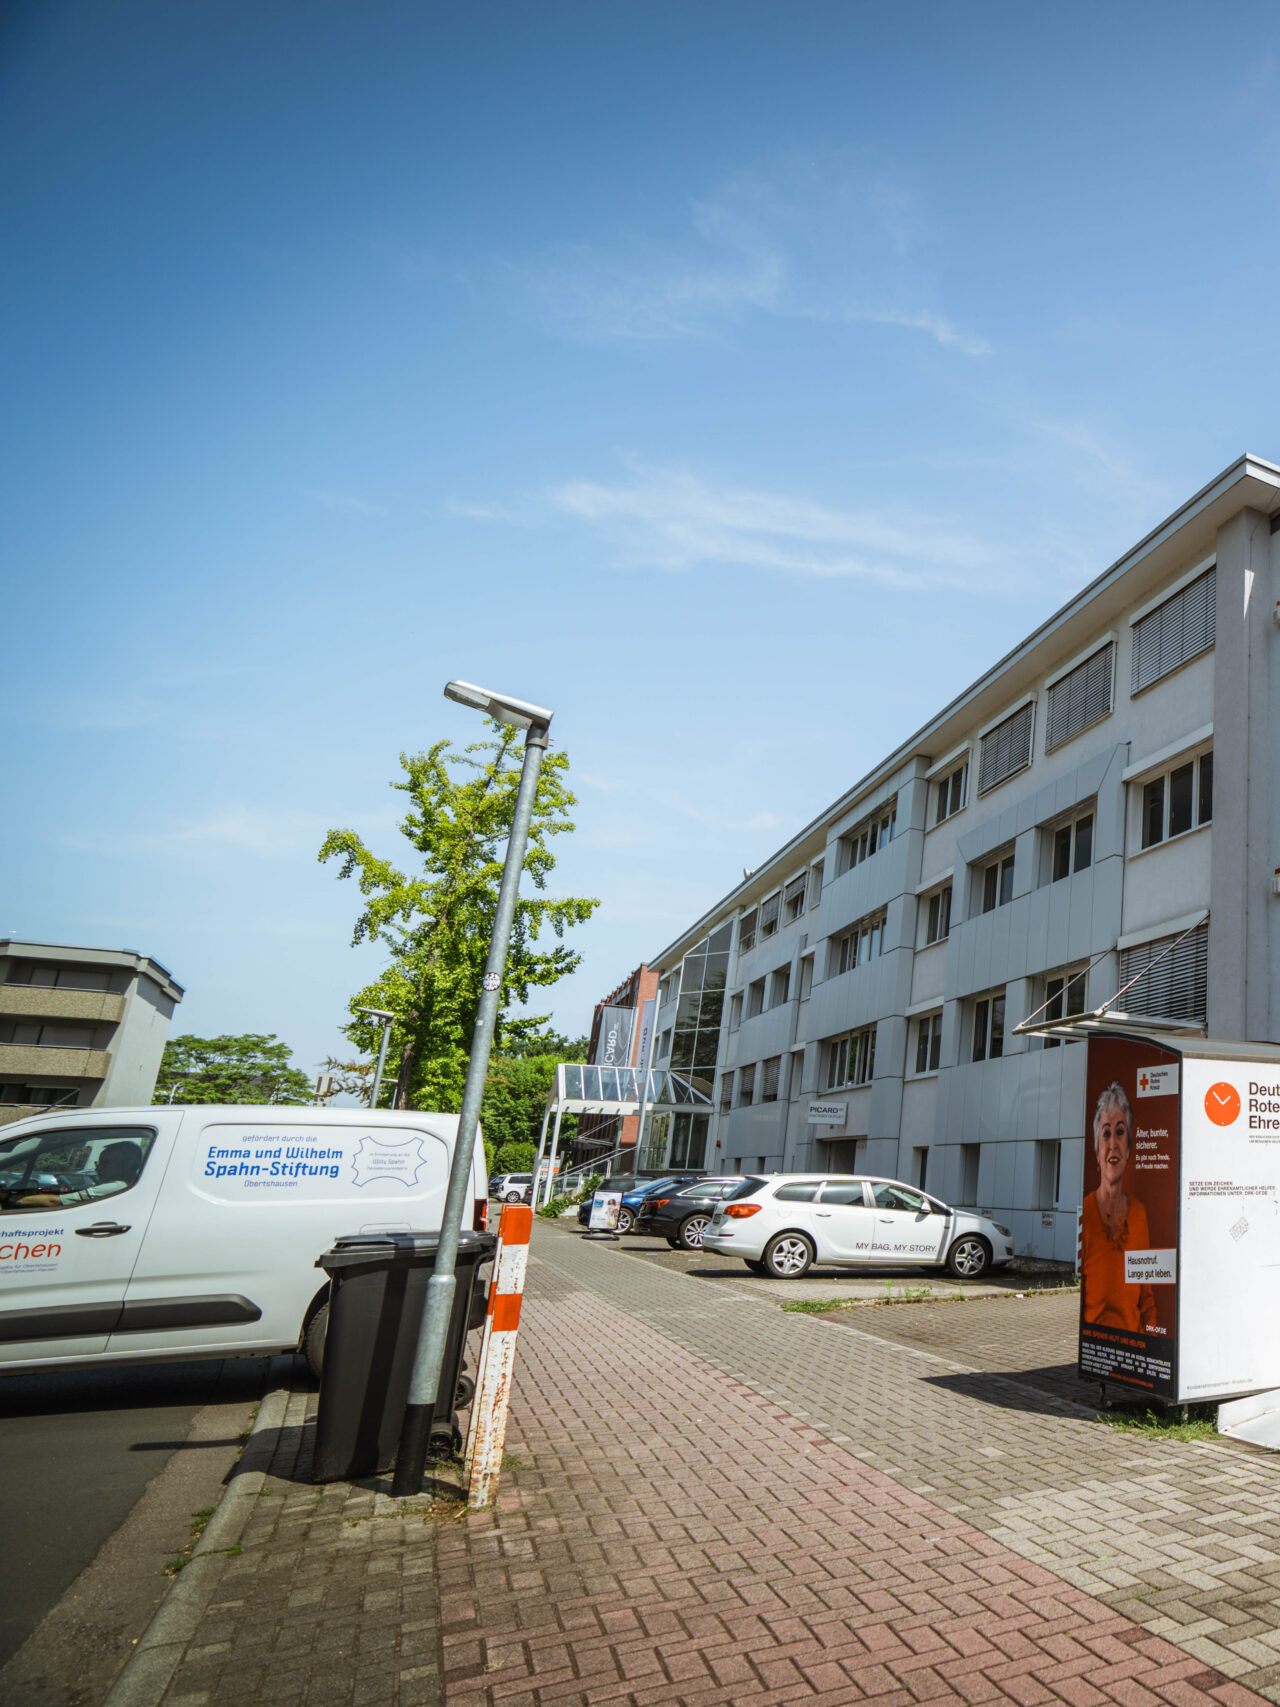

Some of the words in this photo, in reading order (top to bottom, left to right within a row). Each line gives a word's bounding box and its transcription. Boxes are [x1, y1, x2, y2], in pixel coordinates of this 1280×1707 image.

[242, 1135, 280, 1143] gefördert
[208, 1146, 252, 1159] Emma
[255, 1147, 281, 1159] und
[286, 1148, 343, 1160] Wilhelm
[204, 1161, 340, 1179] Spahn-Stiftung
[244, 1179, 298, 1188] Obertshausen
[0, 1228, 64, 1238] haftsprojekt
[856, 1242, 869, 1250] MY
[872, 1243, 891, 1251] BAG.
[909, 1244, 937, 1252] STORY.
[1128, 1256, 1158, 1264] Hausnotruf.
[1128, 1269, 1144, 1280] Lange
[1145, 1269, 1154, 1280] gut
[1155, 1269, 1172, 1278] leben.
